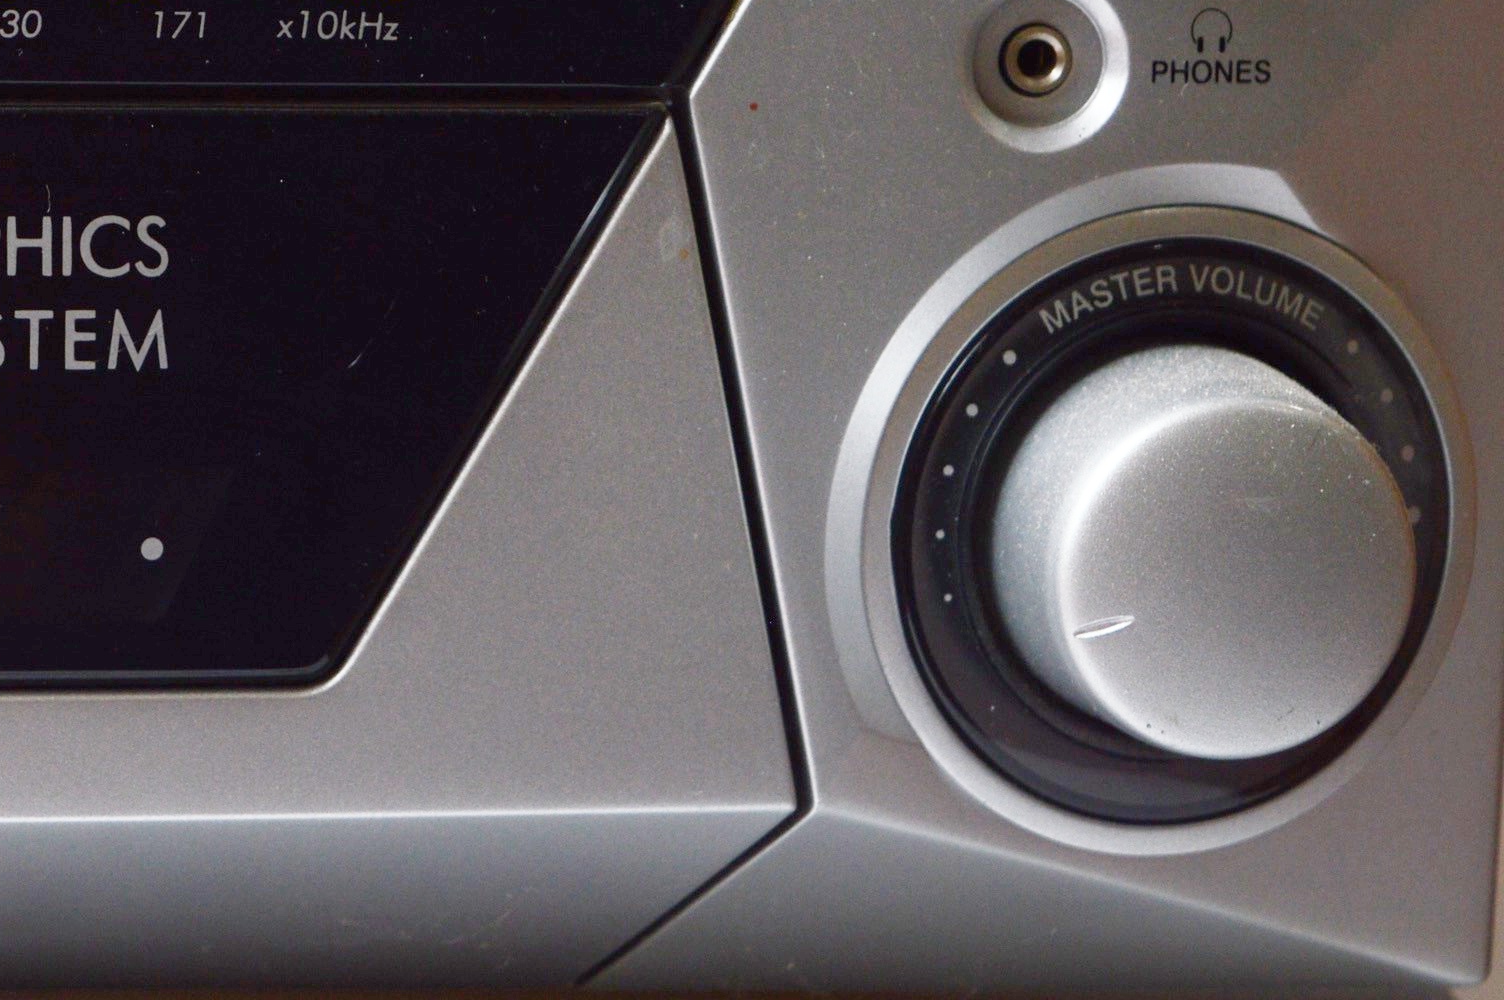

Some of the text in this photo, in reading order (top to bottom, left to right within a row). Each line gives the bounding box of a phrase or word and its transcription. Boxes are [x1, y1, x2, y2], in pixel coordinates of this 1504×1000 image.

[155, 11, 205, 38] 171
[277, 10, 398, 40] x10kHz
[1152, 60, 1270, 84] PHONES
[1038, 264, 1326, 334] MASTER VOLUME
